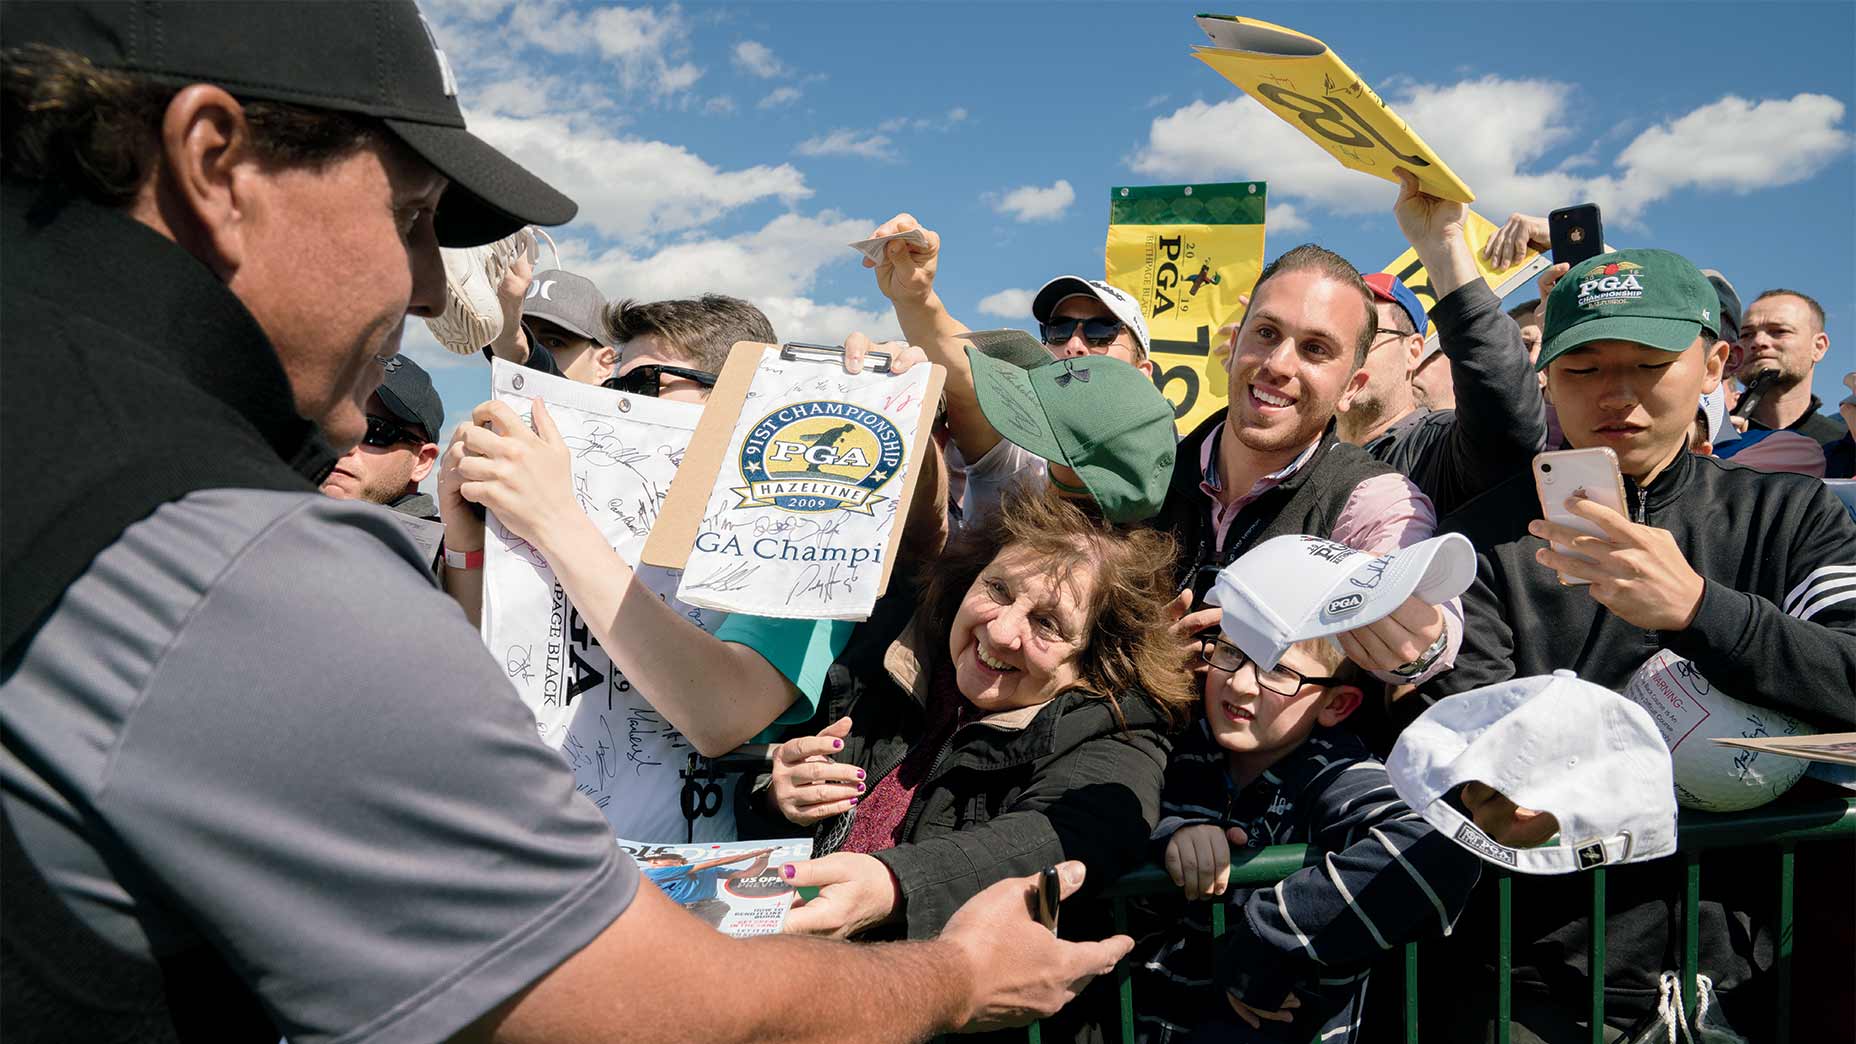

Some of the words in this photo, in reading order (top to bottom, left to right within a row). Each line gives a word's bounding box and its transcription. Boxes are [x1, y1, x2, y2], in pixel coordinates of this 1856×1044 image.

[1142, 235, 1154, 286] BETHPAGE
[1185, 242, 1196, 259] 20
[1152, 234, 1181, 319] PGA
[1577, 275, 1644, 298] PGA
[1180, 298, 1190, 313] 19
[1578, 290, 1643, 306] CHAMPIONSHIP
[1149, 324, 1210, 420] 18
[746, 418, 777, 455] 91ST
[779, 404, 901, 467] CHAMPIONSHIP
[769, 440, 871, 468] PGA
[761, 484, 861, 500] HAZELTINE
[788, 497, 826, 508] 2009
[695, 532, 744, 557] GA
[752, 538, 882, 568] Champi
[550, 577, 565, 638] PAGE
[1330, 596, 1361, 611] PGA
[566, 606, 604, 706] GA
[543, 642, 561, 705] BLACK
